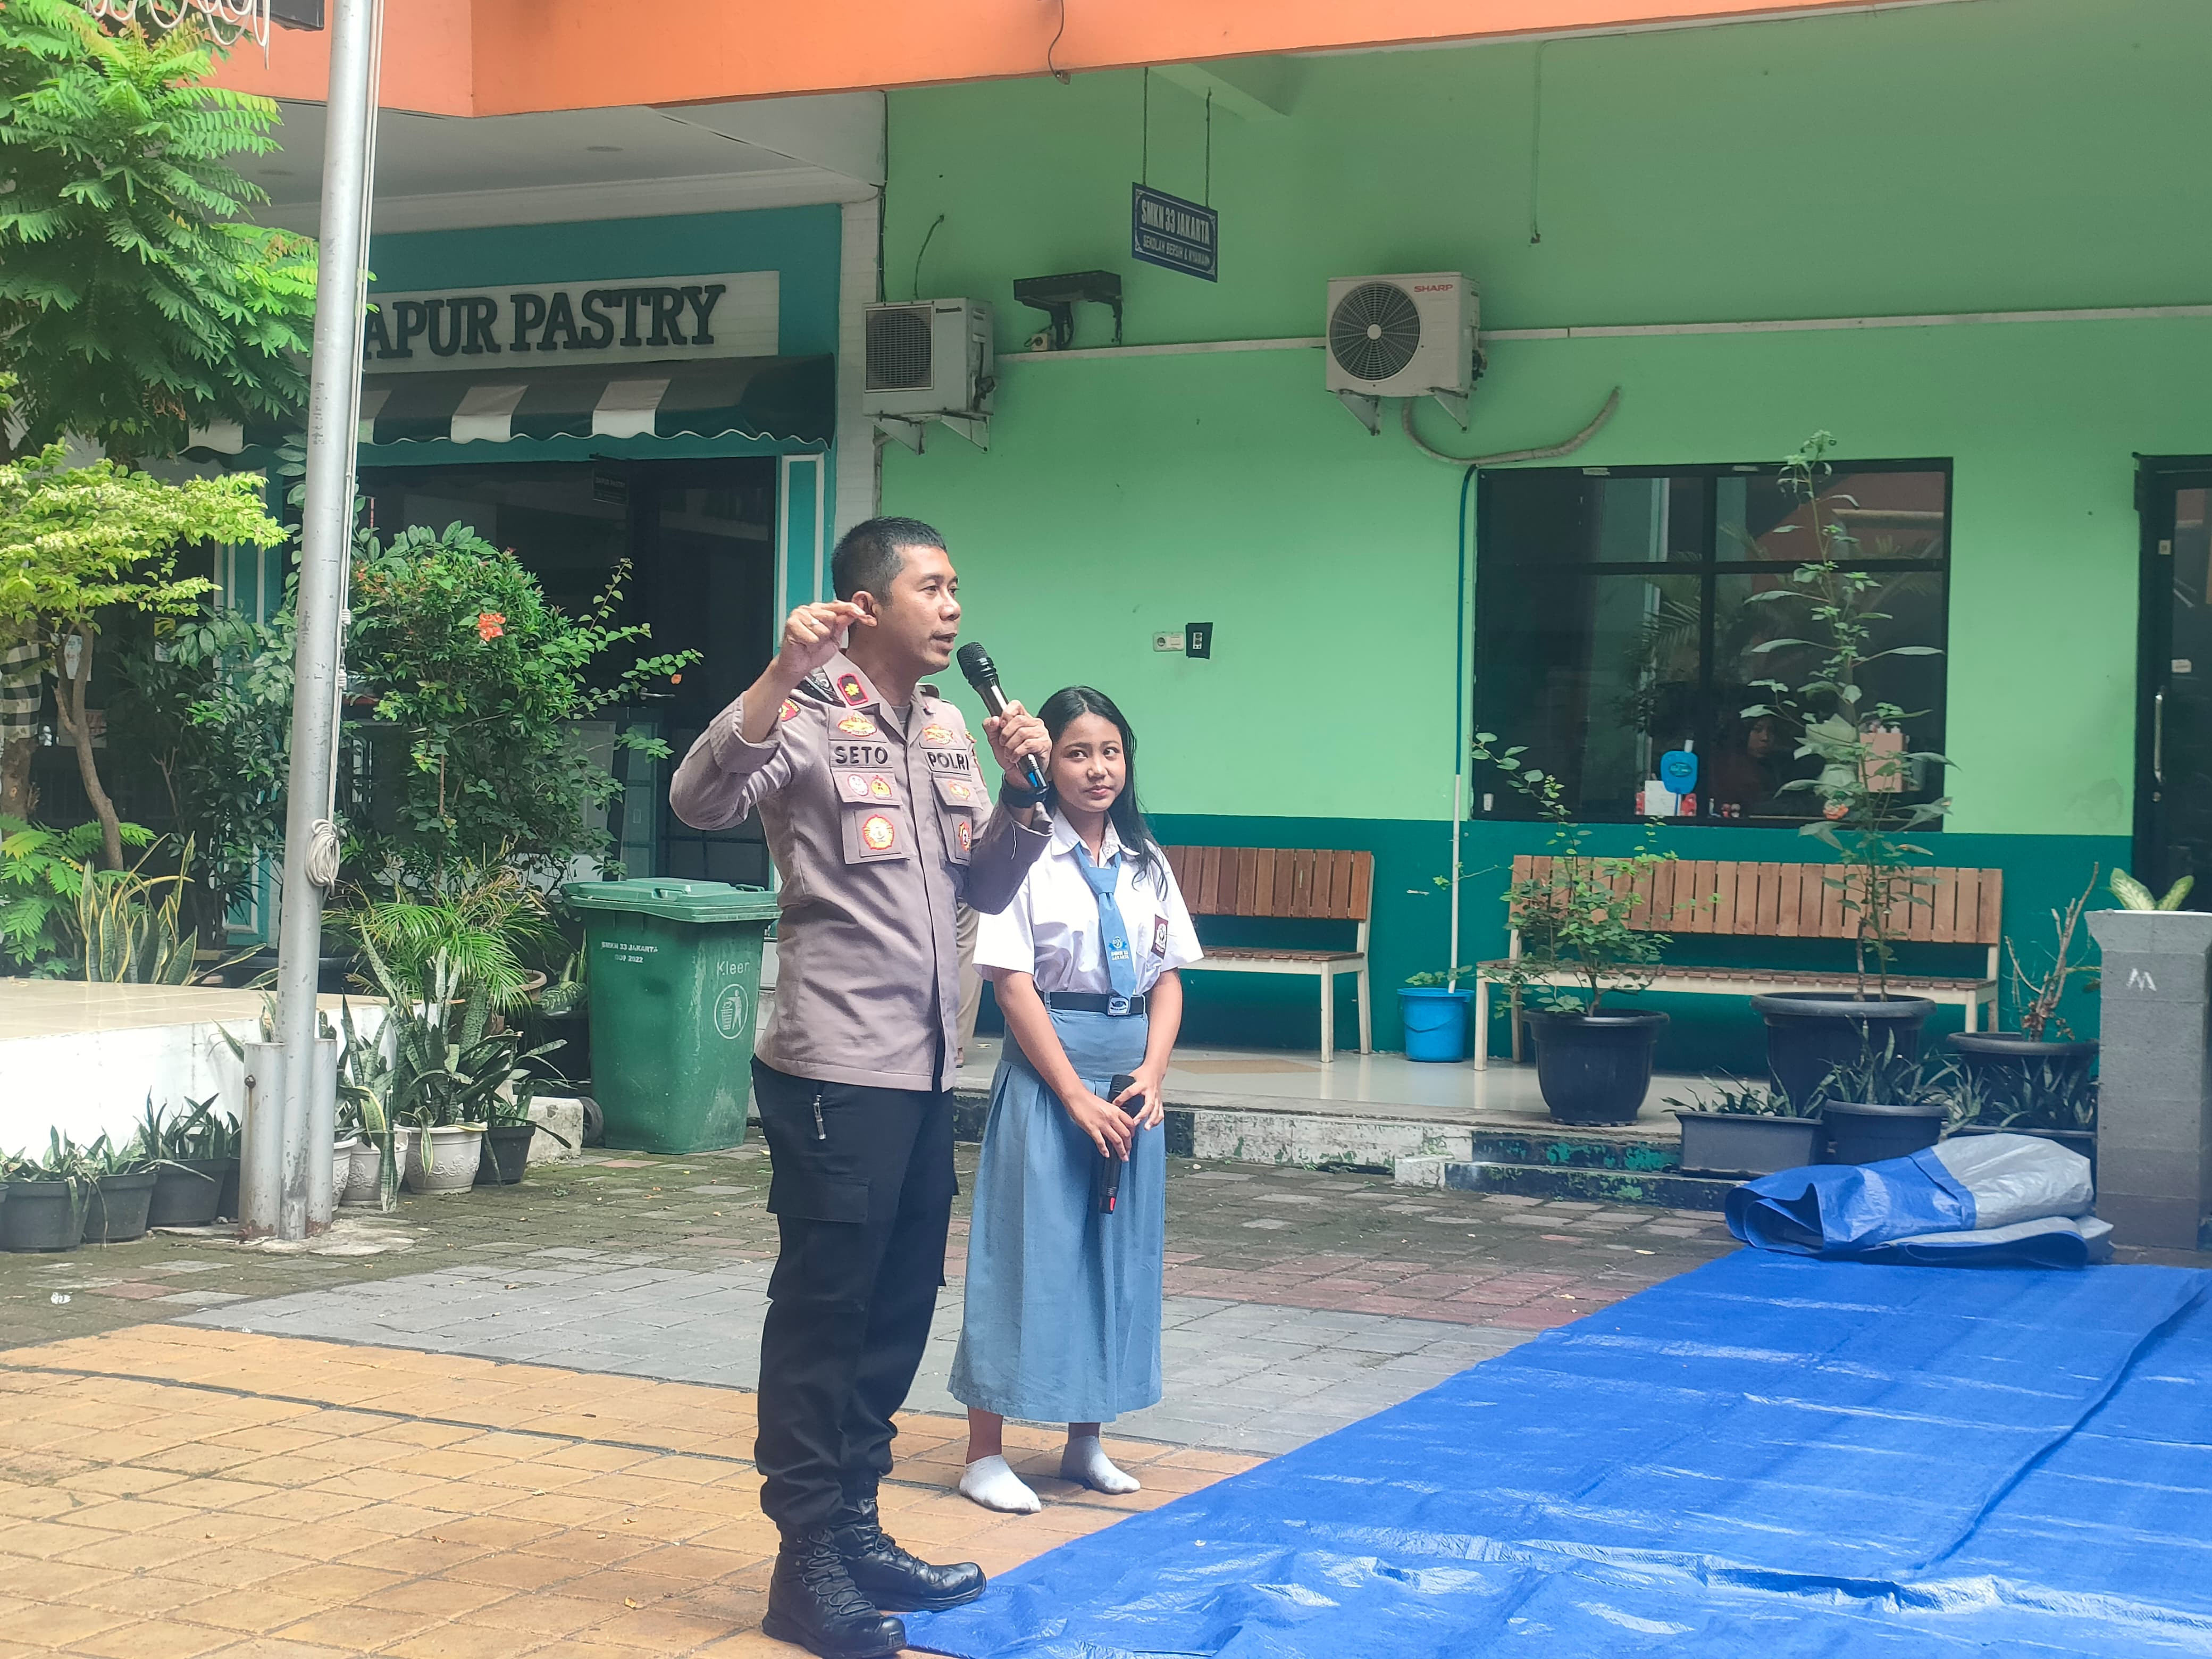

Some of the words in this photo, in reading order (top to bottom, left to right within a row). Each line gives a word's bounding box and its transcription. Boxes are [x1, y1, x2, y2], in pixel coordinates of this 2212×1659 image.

[1142, 199, 1164, 229] SMKN
[1166, 207, 1175, 233] 33
[1177, 212, 1210, 245] JAKARTA
[1414, 284, 1454, 292] SHARP
[364, 296, 501, 360] APUR
[509, 284, 726, 352] PASTRY
[834, 745, 889, 765] SETO
[927, 751, 970, 771] POLRI
[629, 944, 659, 953] JAKARTA
